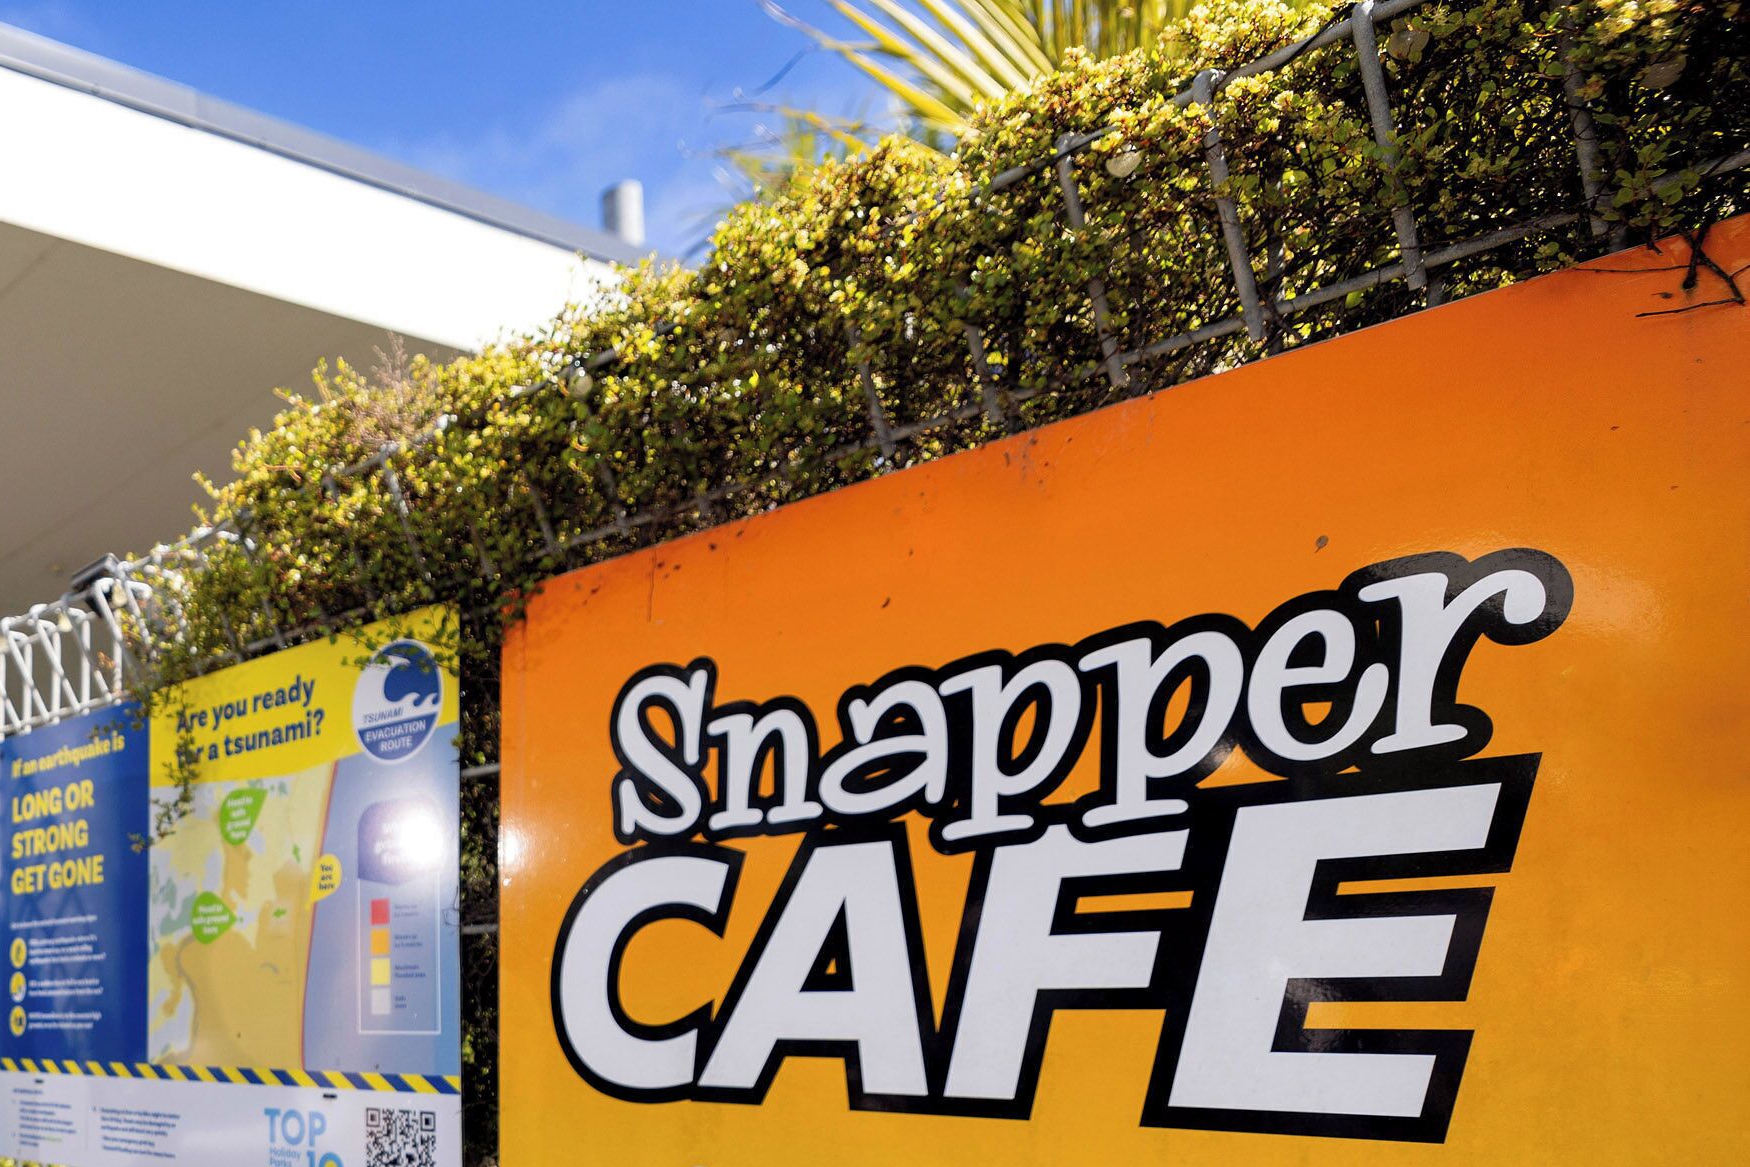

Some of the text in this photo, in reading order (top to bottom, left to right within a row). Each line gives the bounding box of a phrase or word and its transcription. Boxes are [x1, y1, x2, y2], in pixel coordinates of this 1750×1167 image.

[176, 674, 316, 734] Are you ready
[363, 707, 404, 724] TSUNAMI
[610, 548, 1574, 854] Snapper
[208, 742, 219, 761] a
[224, 708, 325, 757] tsunami?
[365, 720, 427, 743] EVACUATION
[380, 736, 413, 752] ROUTE
[11, 730, 126, 779] If an earthquake is
[12, 779, 95, 824] LONG OR
[11, 819, 89, 860] STRONG
[11, 854, 105, 895] GET GONE
[318, 881, 335, 891] here
[320, 864, 333, 872] You
[550, 752, 1540, 1145] CAFE
[264, 1107, 327, 1147] TOP
[269, 1147, 301, 1161] Holiday
